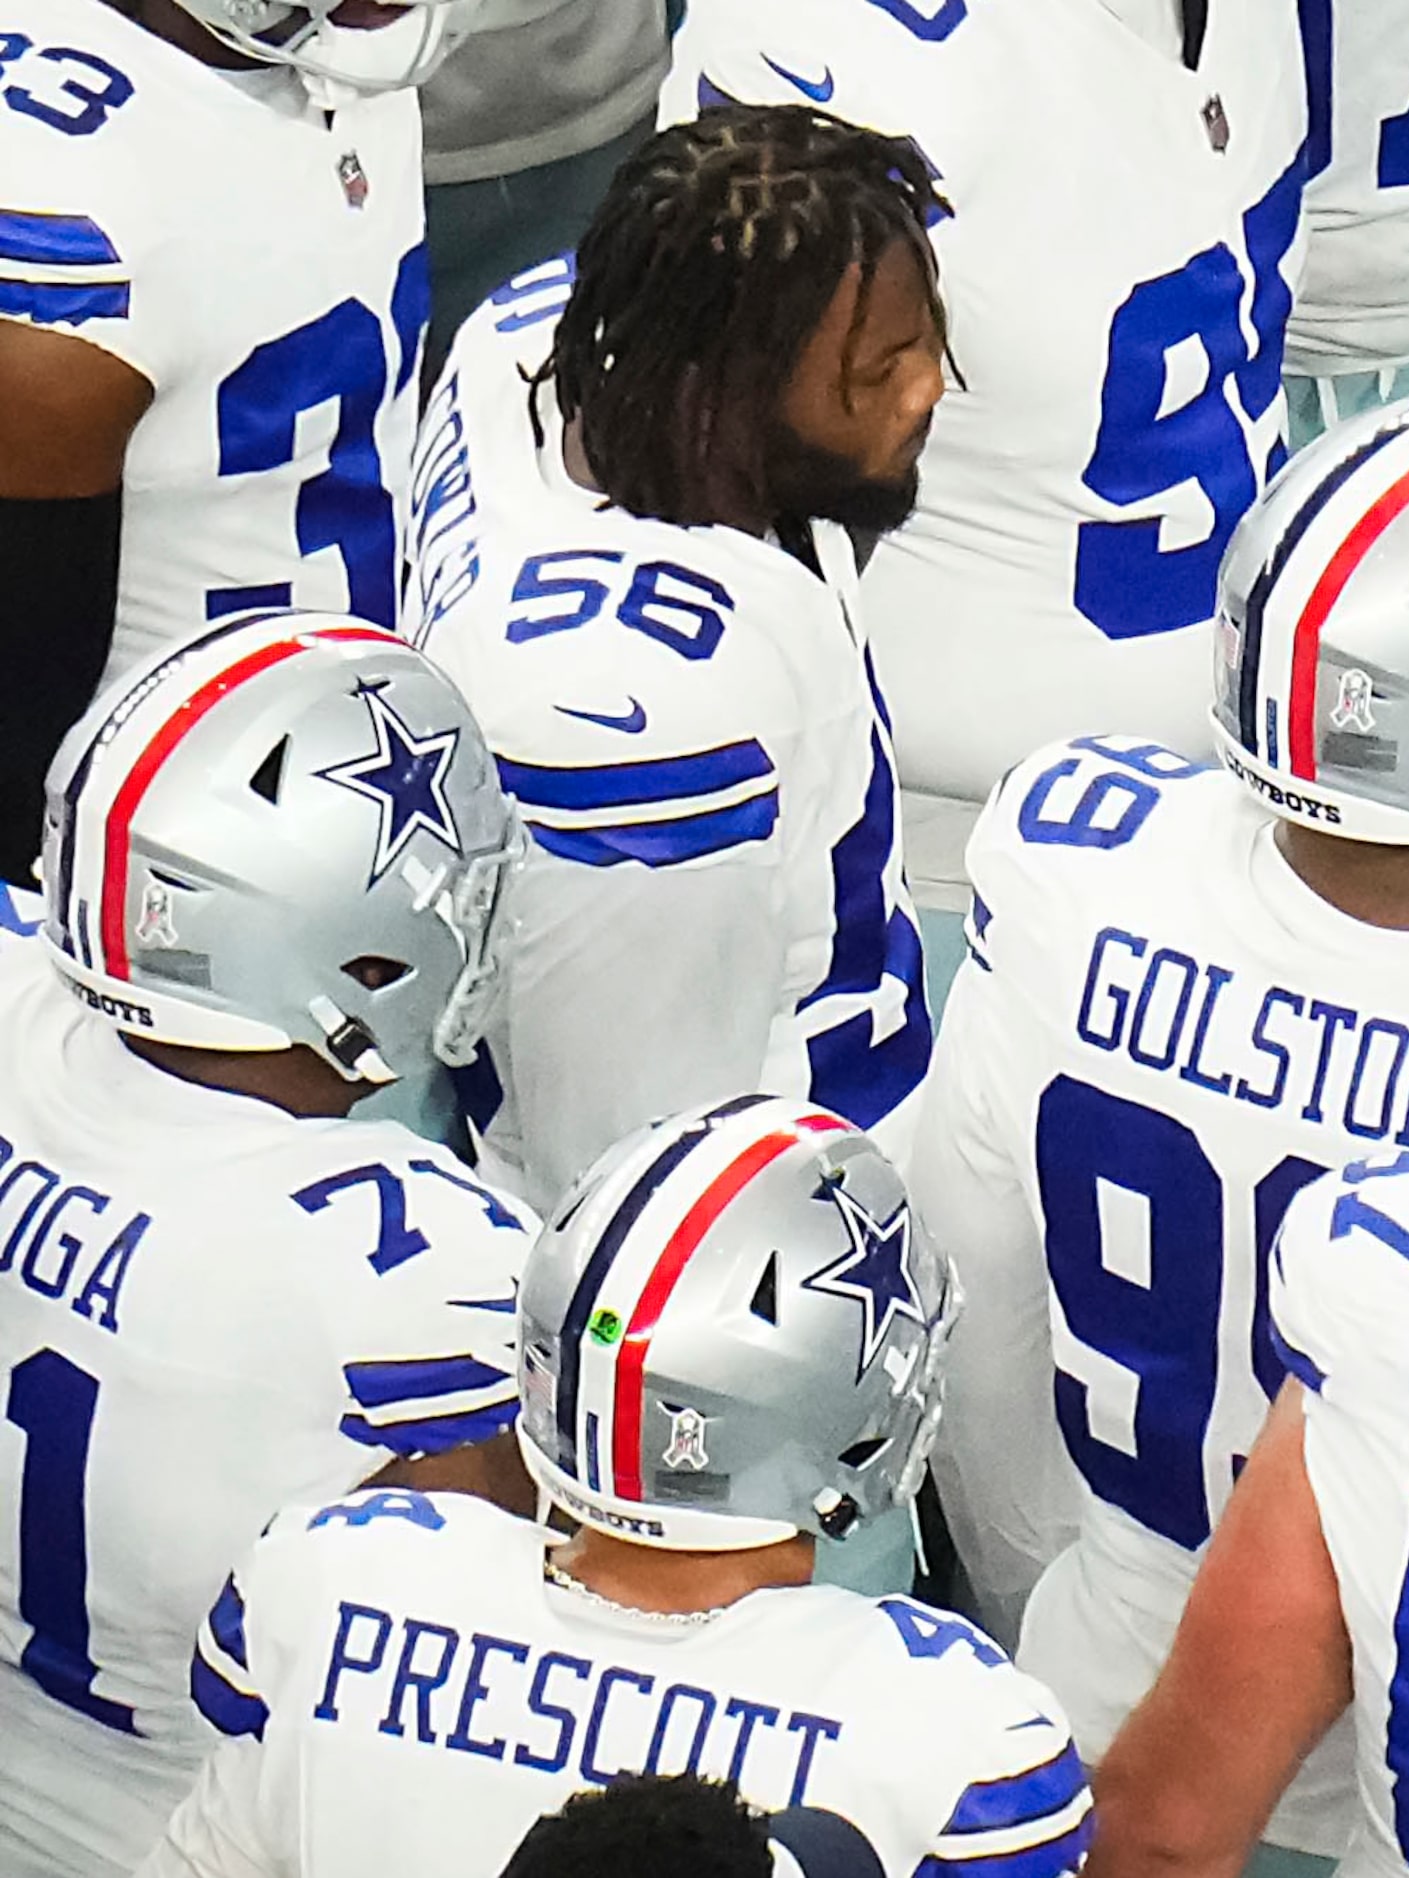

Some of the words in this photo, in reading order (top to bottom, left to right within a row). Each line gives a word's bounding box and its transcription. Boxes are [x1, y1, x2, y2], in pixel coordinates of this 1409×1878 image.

[505, 549, 735, 662] 56
[876, 1600, 1009, 1668] 4
[313, 1600, 843, 1810] PRESCOTT
